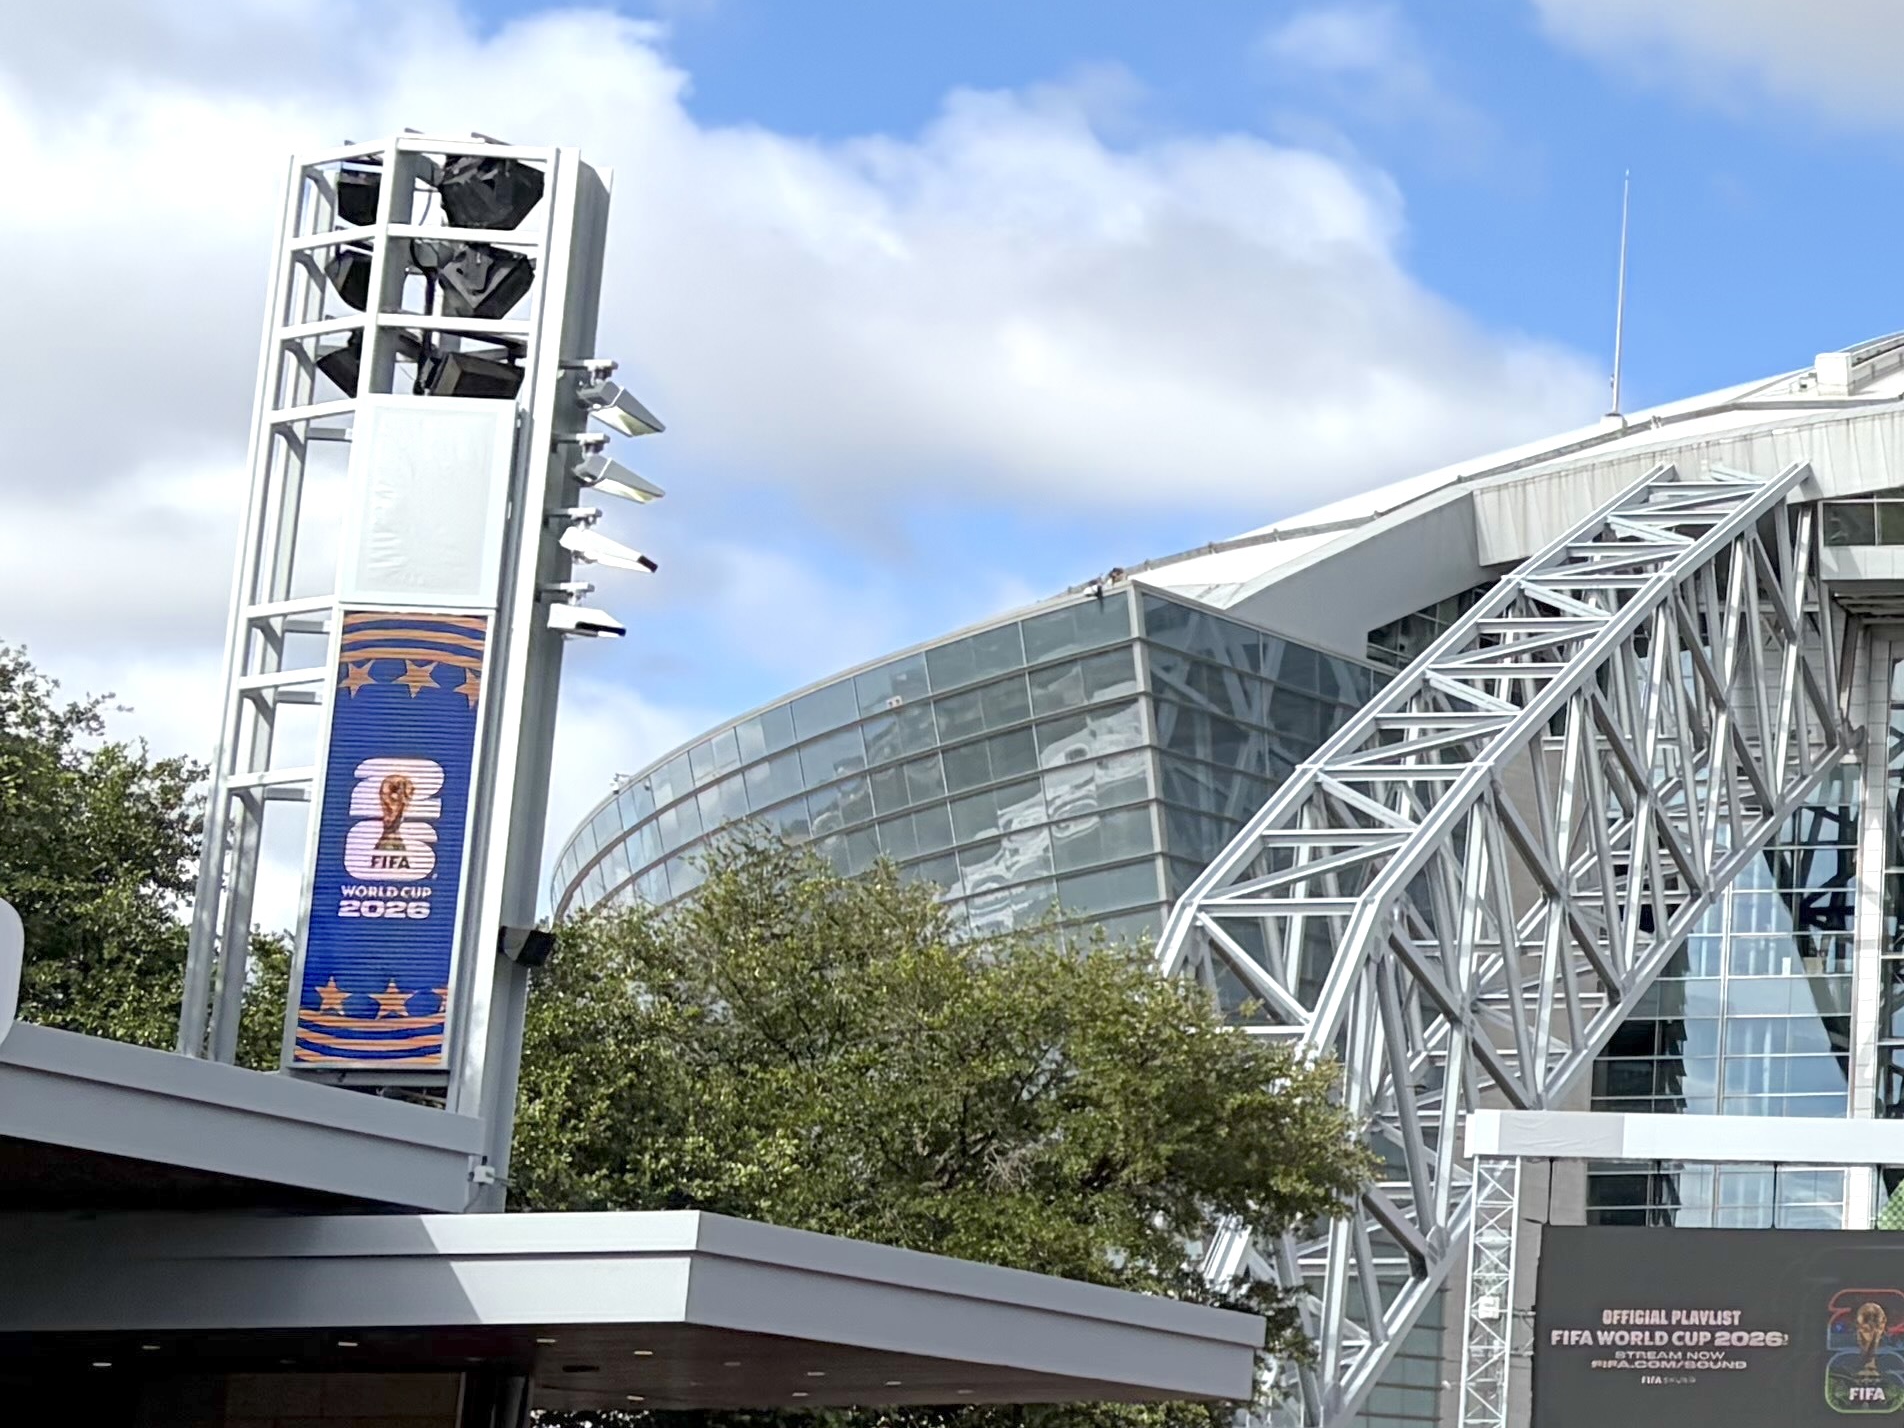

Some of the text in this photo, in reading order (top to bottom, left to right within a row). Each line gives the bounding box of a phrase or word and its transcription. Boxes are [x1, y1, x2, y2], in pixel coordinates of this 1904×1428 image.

[371, 855, 411, 870] FIFA
[341, 885, 432, 899] WORLD CUP
[337, 901, 432, 919] 2026
[1602, 1310, 1742, 1326] OFFICIAL PLAYLIST
[1550, 1330, 1784, 1347] FIFA WORLD CUP 2026
[1614, 1351, 1725, 1360] STREAM NOW
[1591, 1360, 1748, 1370] FIFA.COM/SOUND
[1848, 1387, 1886, 1402] FIFA
